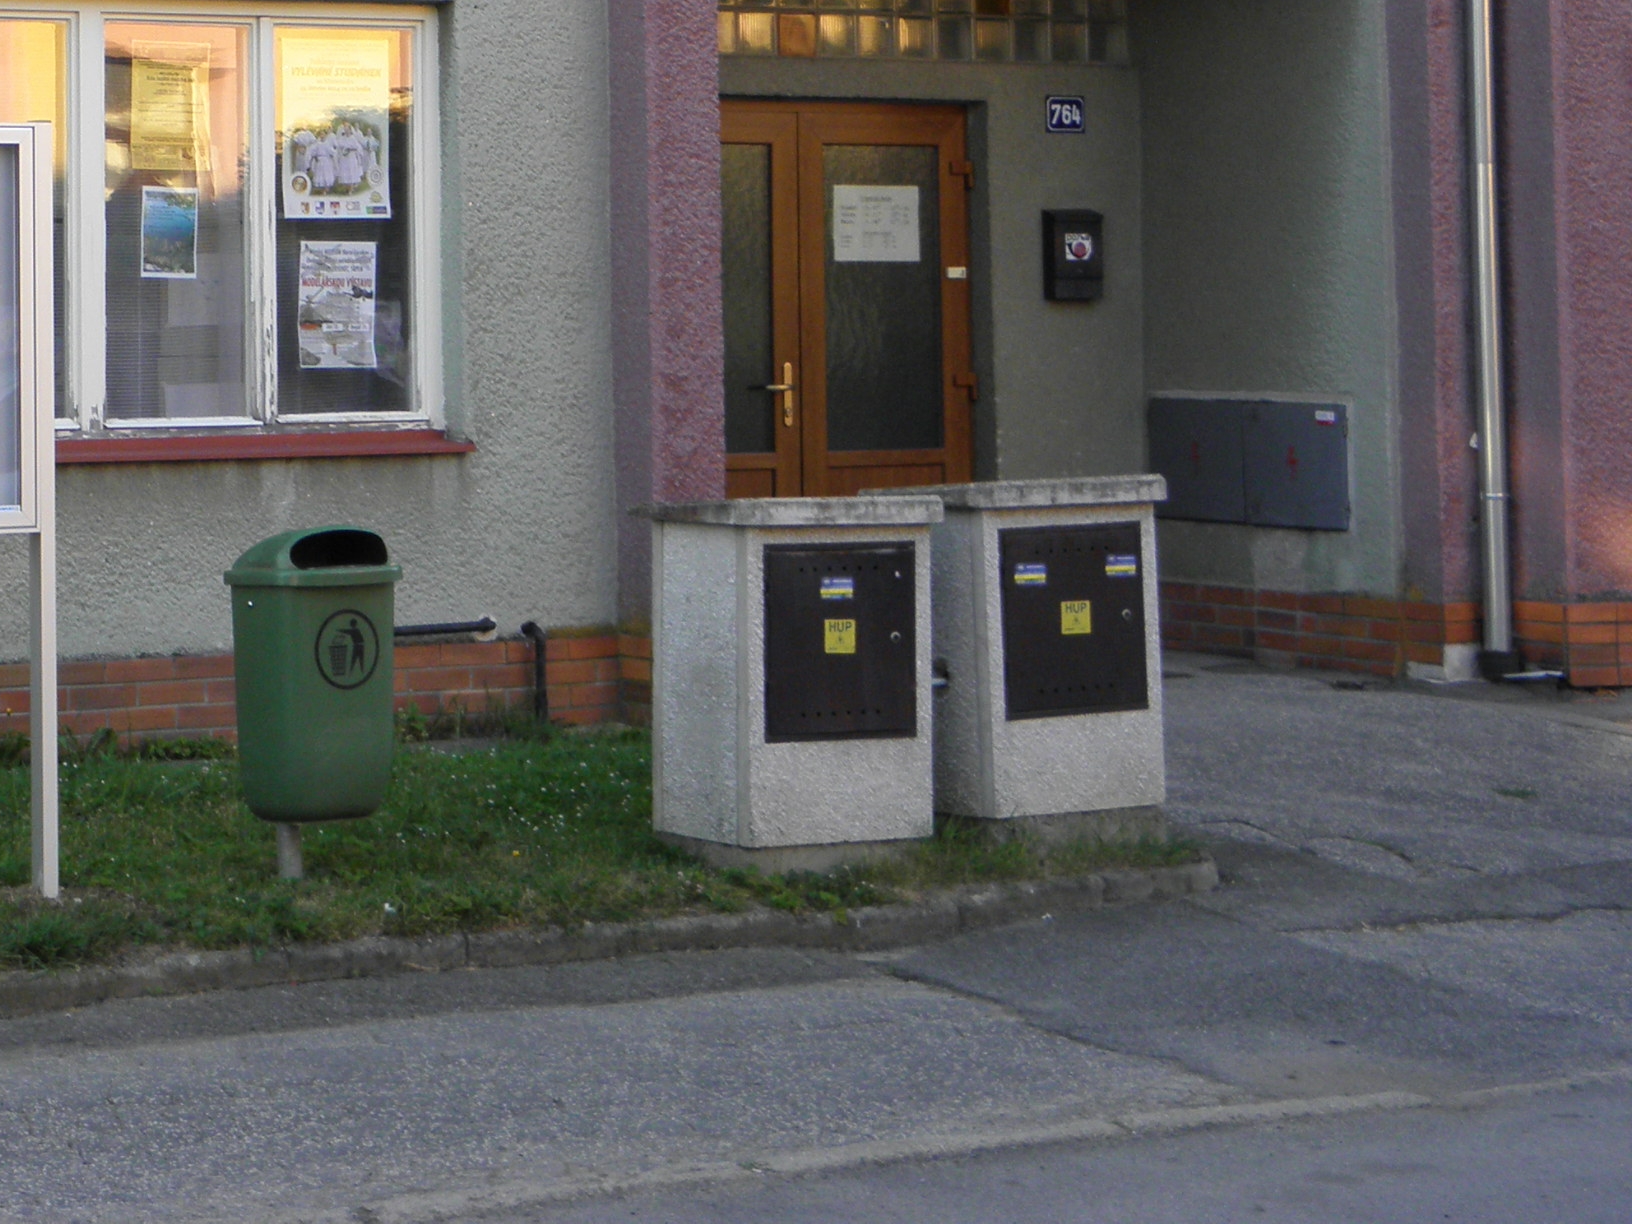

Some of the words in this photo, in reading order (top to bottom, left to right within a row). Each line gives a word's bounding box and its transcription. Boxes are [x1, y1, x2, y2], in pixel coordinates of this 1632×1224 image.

[1051, 104, 1081, 124] 764
[1065, 602, 1087, 614] HUP
[829, 621, 852, 632] HUP
